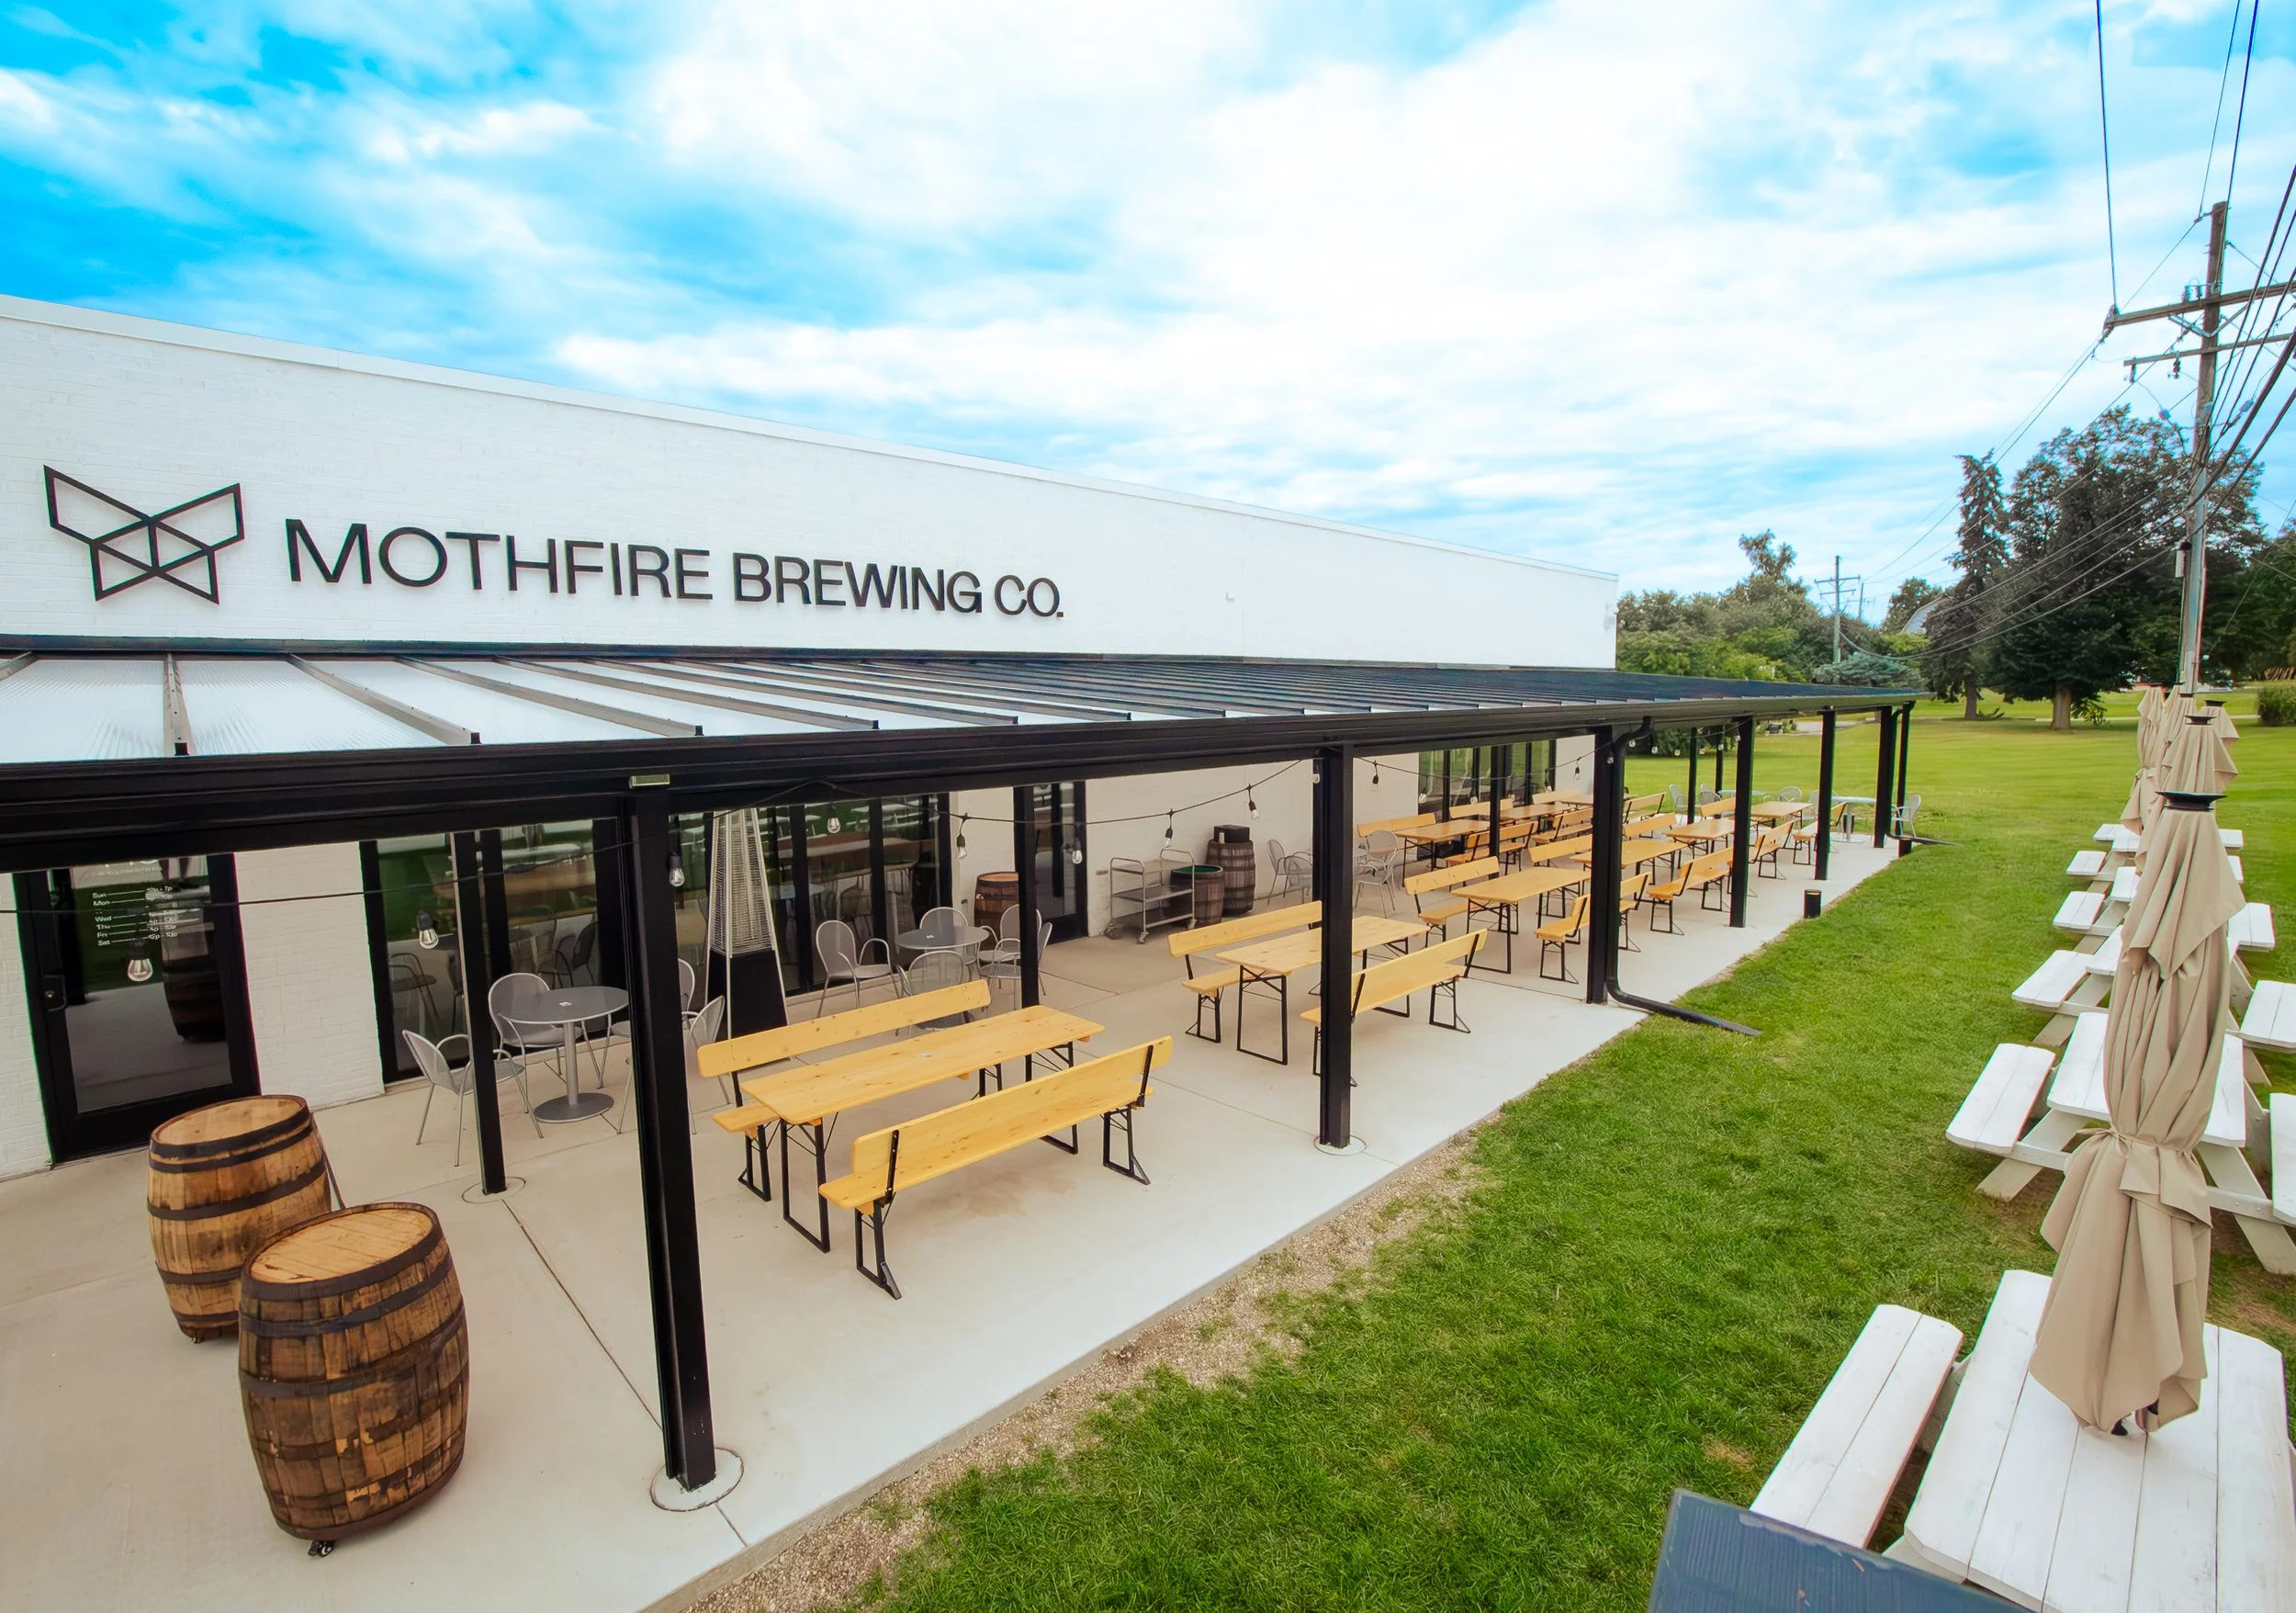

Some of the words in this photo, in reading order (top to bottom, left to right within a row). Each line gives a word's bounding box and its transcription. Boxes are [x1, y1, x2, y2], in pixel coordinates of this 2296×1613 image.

[285, 518, 714, 600] MOTHFIRE
[733, 552, 983, 614] BREWING
[995, 575, 1064, 618] CO.
